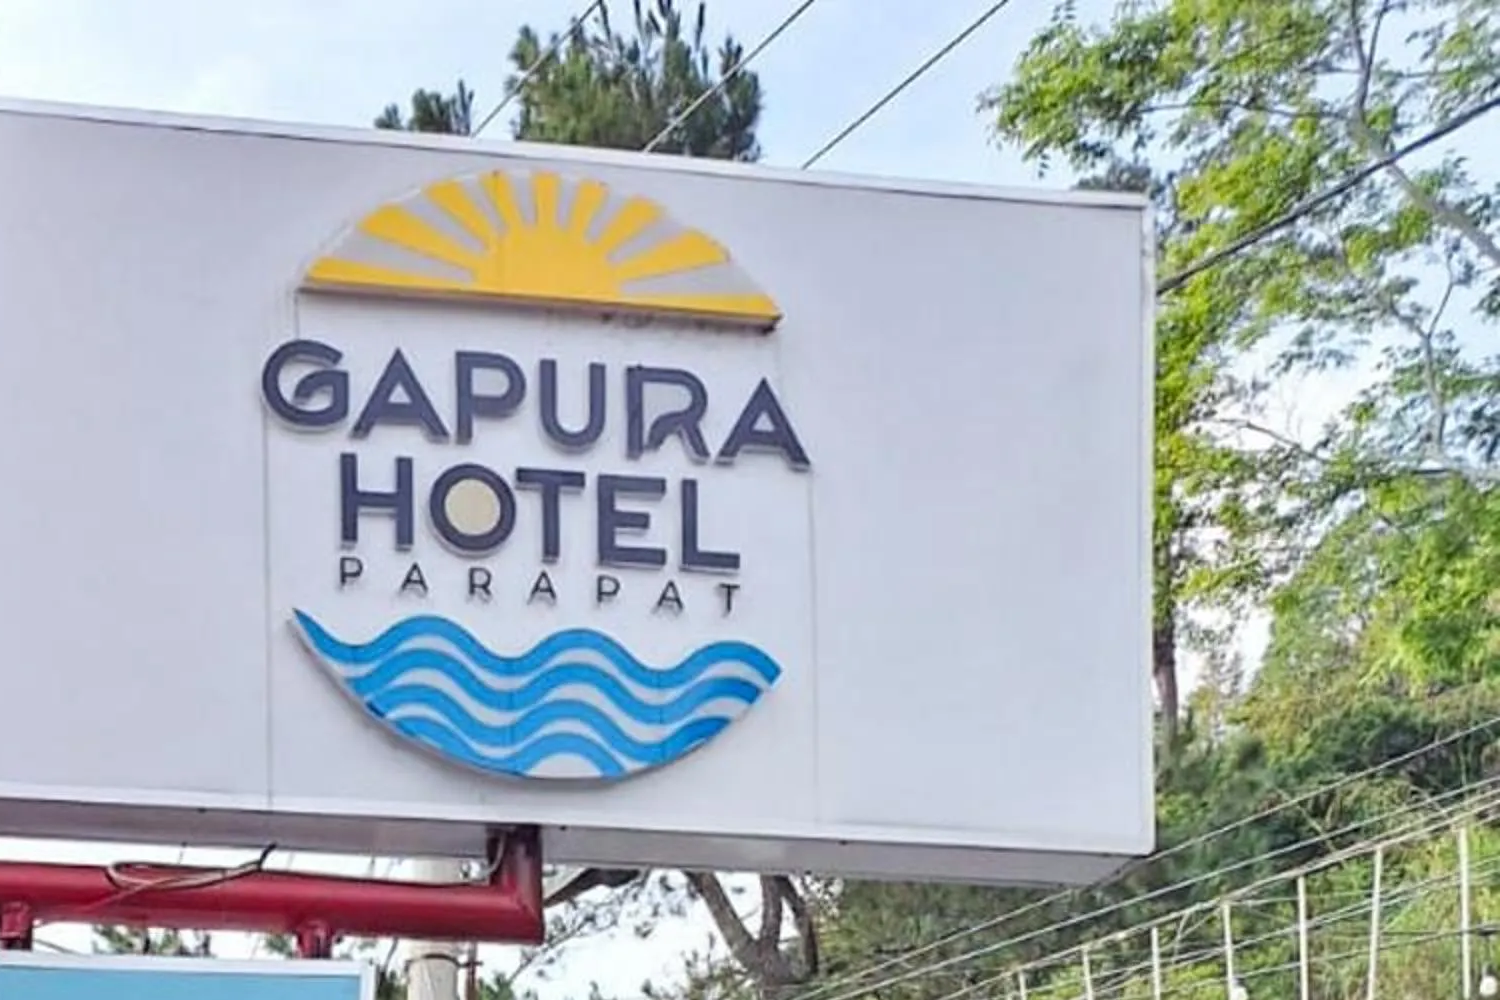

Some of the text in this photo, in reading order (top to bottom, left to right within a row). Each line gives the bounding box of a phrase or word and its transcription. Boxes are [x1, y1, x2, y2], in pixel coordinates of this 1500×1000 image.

[262, 338, 811, 472] GAPURA
[337, 452, 741, 572] HOTEL
[339, 556, 741, 616] PARAPAT
